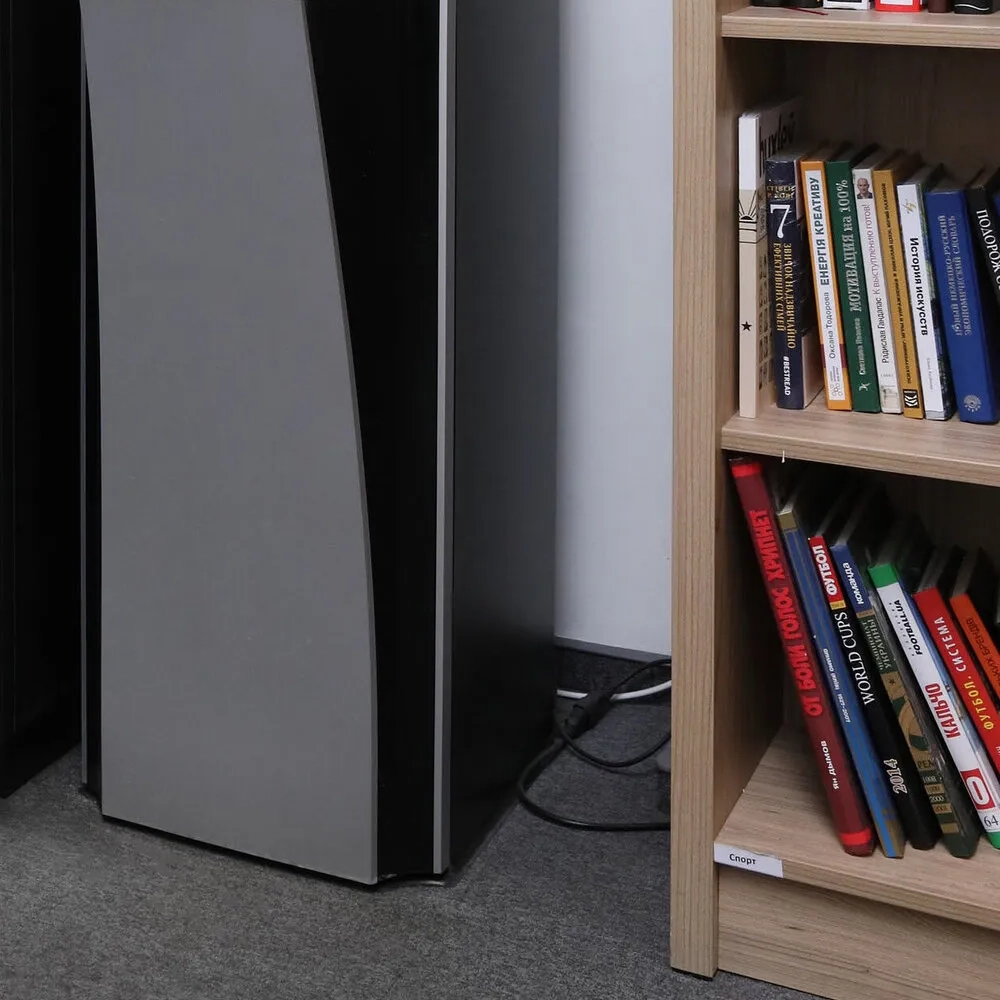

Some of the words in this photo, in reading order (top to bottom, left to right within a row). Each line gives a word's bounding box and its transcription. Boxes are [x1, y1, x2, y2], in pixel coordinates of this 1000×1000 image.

[809, 177, 825, 235] КРЕАТИВУ
[836, 180, 851, 213] 100%
[865, 204, 873, 230] готов!
[770, 204, 791, 239] 7
[844, 215, 853, 232] на
[976, 209, 1000, 273] ПОДОРОЖ
[774, 243, 783, 304] ЕФЕКТИВНИХ
[783, 243, 793, 280] ЗВИЧОК
[816, 239, 830, 286] ЕНЕРГІЯ
[842, 235, 862, 312] МОТИВАЦИЯ
[867, 230, 881, 288] выступлению
[910, 237, 921, 284] История
[917, 286, 928, 336] искусств
[776, 305, 785, 331] СІМЕЙ
[784, 281, 796, 349] НАДЗВИЧАЙНО
[824, 292, 833, 329] Тодорова
[876, 297, 887, 330] Гандапас
[826, 330, 836, 359] Оксана
[879, 331, 889, 364] Радислав
[750, 509, 786, 582] ХРИПНЕТ
[812, 544, 838, 596] ФУТБОЛ
[842, 562, 864, 605] команда
[771, 586, 800, 640] ГОЛОС
[834, 611, 857, 648] CUPS
[894, 600, 922, 655] FOOTBALL.UA
[786, 644, 816, 691] БОЛИ
[867, 619, 892, 669] УКРАИНЫ
[934, 616, 967, 672] СИСТЕМА
[848, 651, 876, 705] WORLD
[803, 696, 823, 717] ОТ
[925, 682, 961, 739] КАЛЬЧО
[963, 675, 995, 730] ФУТБОЛ.
[820, 740, 836, 776] ДЫМОВ
[883, 758, 908, 794] 2014
[983, 815, 999, 827] 64
[729, 853, 757, 865] Спорт
